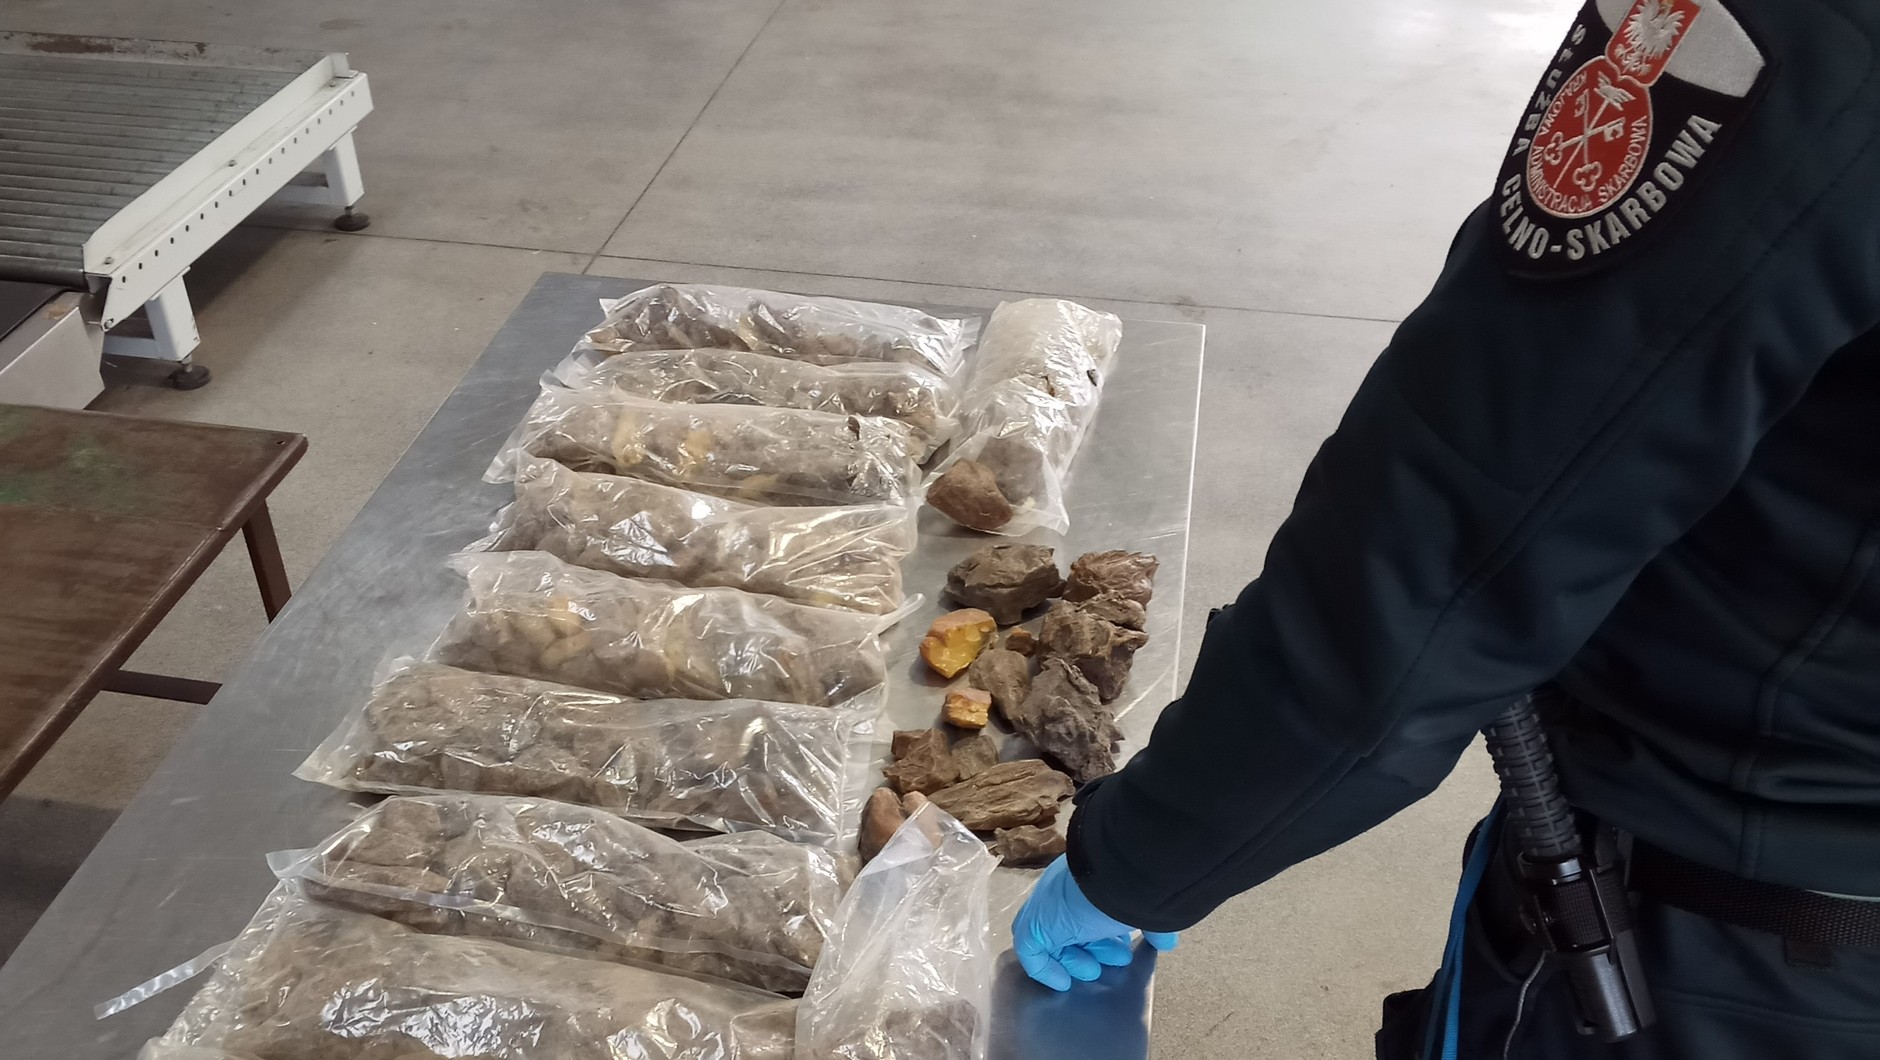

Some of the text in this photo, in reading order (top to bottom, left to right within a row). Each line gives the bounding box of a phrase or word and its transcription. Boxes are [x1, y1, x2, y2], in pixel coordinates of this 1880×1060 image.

[1501, 114, 1722, 260] CELNO-SKARBOWA
[1529, 145, 1593, 213] ADMINISTRACJA
[1598, 115, 1648, 202] SKARBOWA
